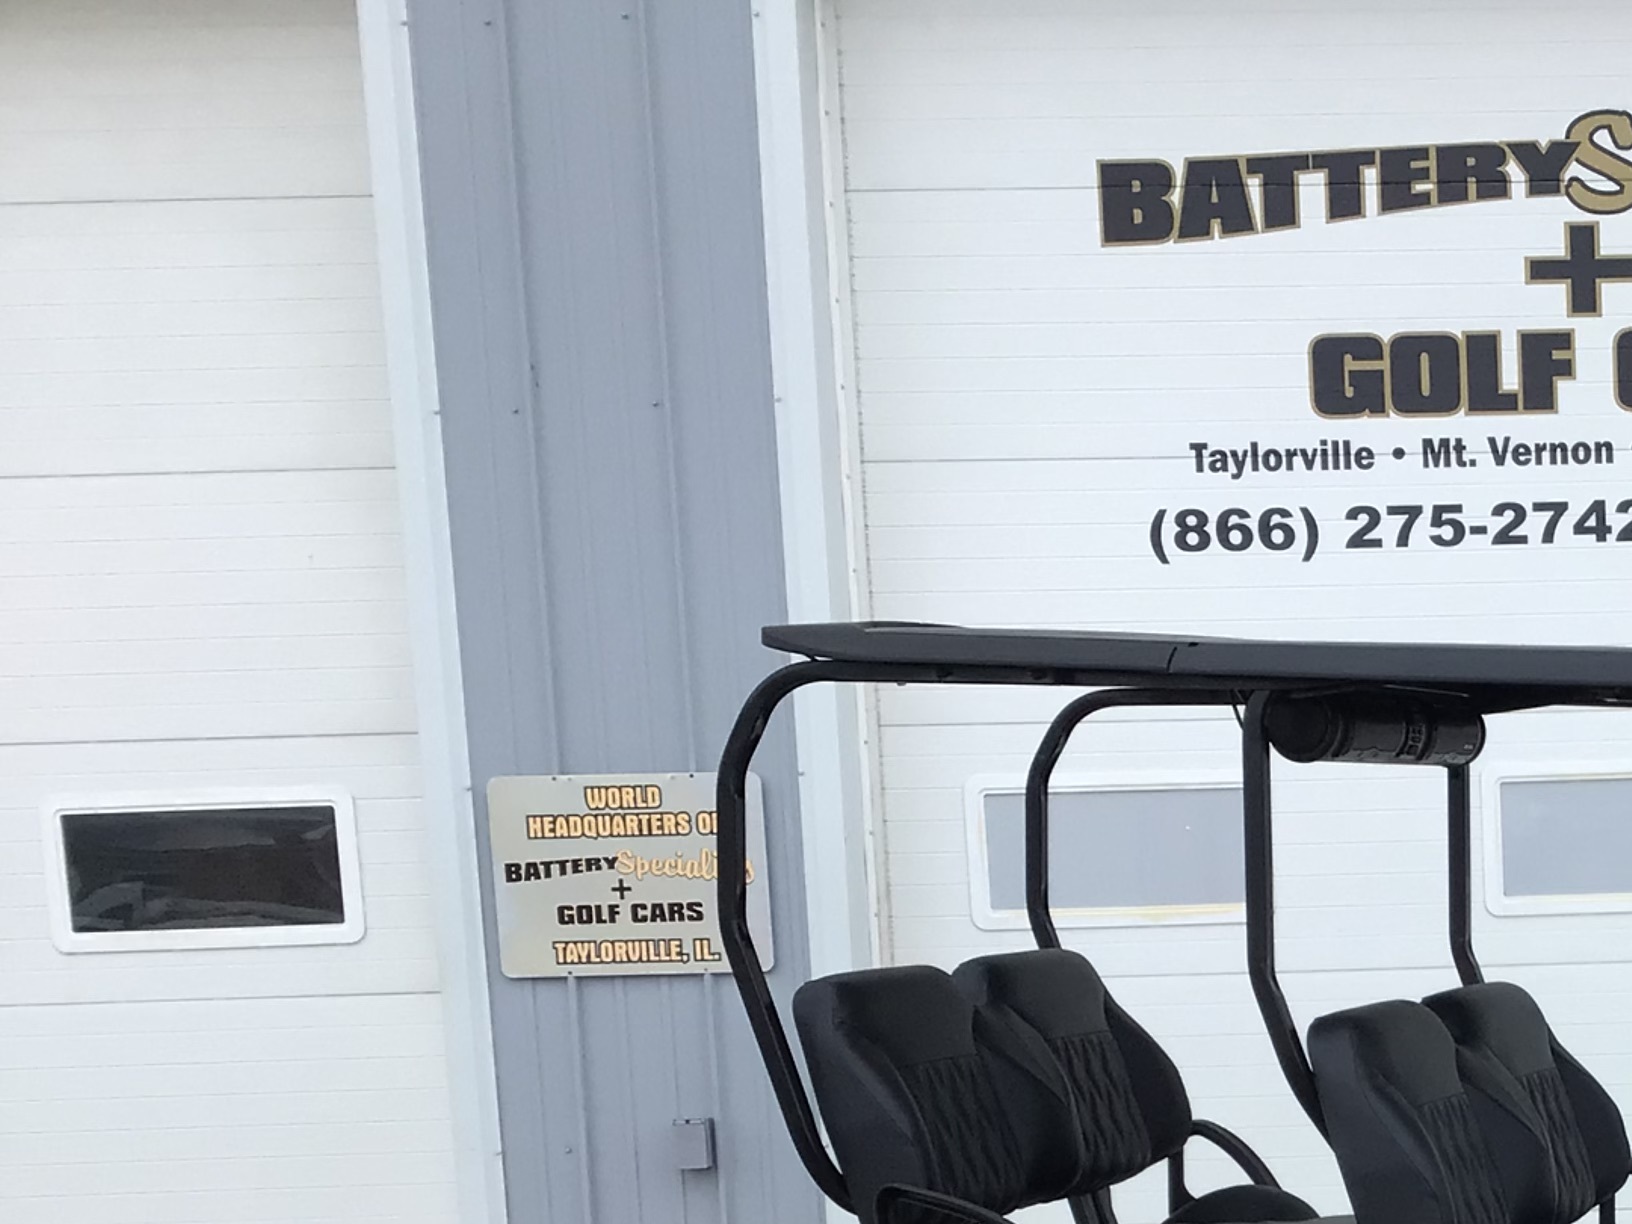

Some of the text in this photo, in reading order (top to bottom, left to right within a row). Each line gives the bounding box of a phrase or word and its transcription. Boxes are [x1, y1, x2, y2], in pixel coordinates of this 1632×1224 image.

[1095, 138, 1580, 248] BATTERY
[1308, 328, 1576, 419] GOLF
[1189, 440, 1376, 479] Taylorville
[1421, 436, 1478, 468] Mt.
[1486, 435, 1615, 466] Vernon
[1148, 507, 1321, 564] (866)
[584, 784, 662, 810] WORLD
[526, 812, 692, 840] HEADQUARTERS
[504, 856, 619, 883] BATTERY
[557, 901, 704, 925] GOLF CARS
[552, 937, 722, 965] TAYLORVILLE, IL.
